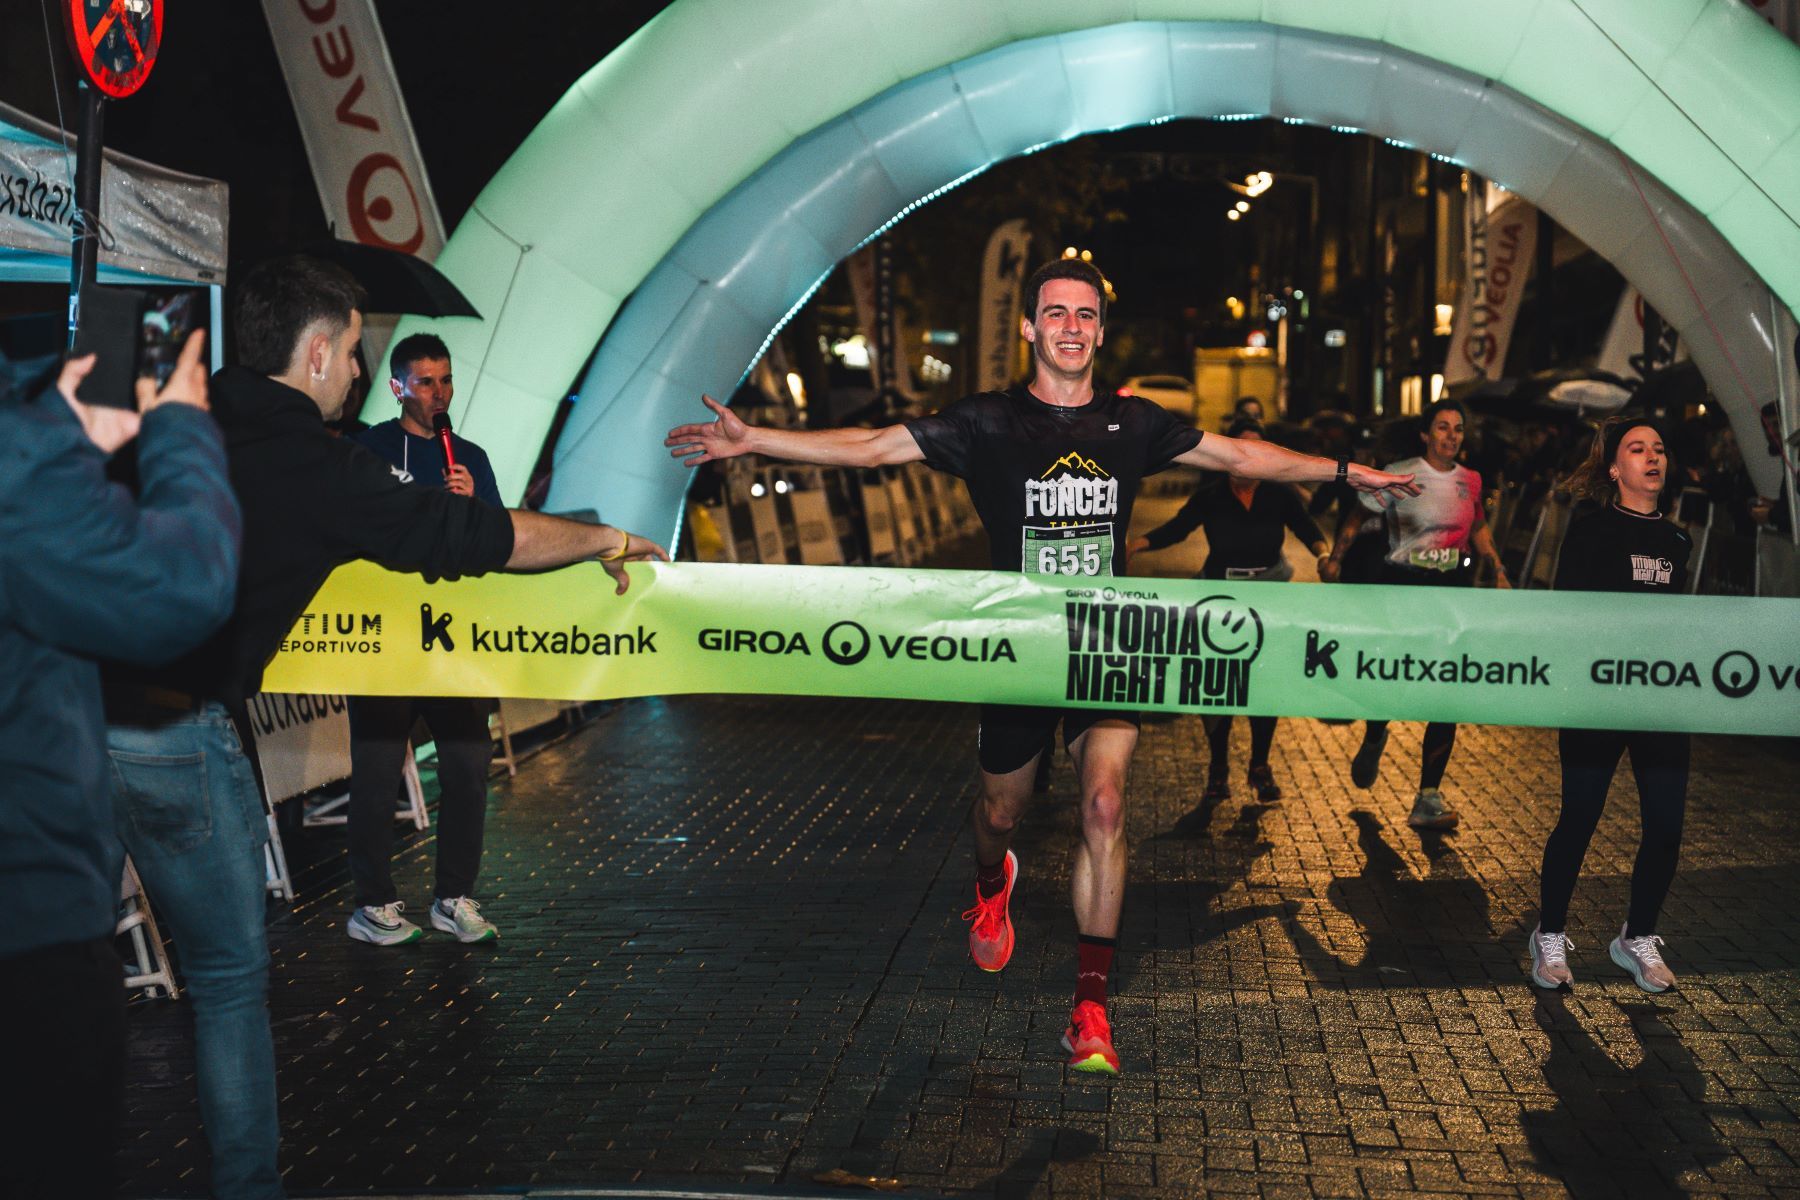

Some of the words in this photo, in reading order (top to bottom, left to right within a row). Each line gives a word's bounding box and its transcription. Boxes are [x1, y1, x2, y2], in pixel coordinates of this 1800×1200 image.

[1038, 544, 1100, 576] 655
[1118, 591, 1159, 600] VEOLIA
[471, 623, 657, 656] kutxabank
[1065, 602, 1201, 656] VITORIA
[698, 629, 811, 656] GIROA
[878, 635, 1017, 663] VEOLIA
[1065, 654, 1171, 705] NIGHT
[1178, 657, 1250, 707] RUN
[1356, 651, 1550, 686] kutxabank
[1591, 659, 1701, 687] GIROA
[1768, 664, 1800, 690] V
